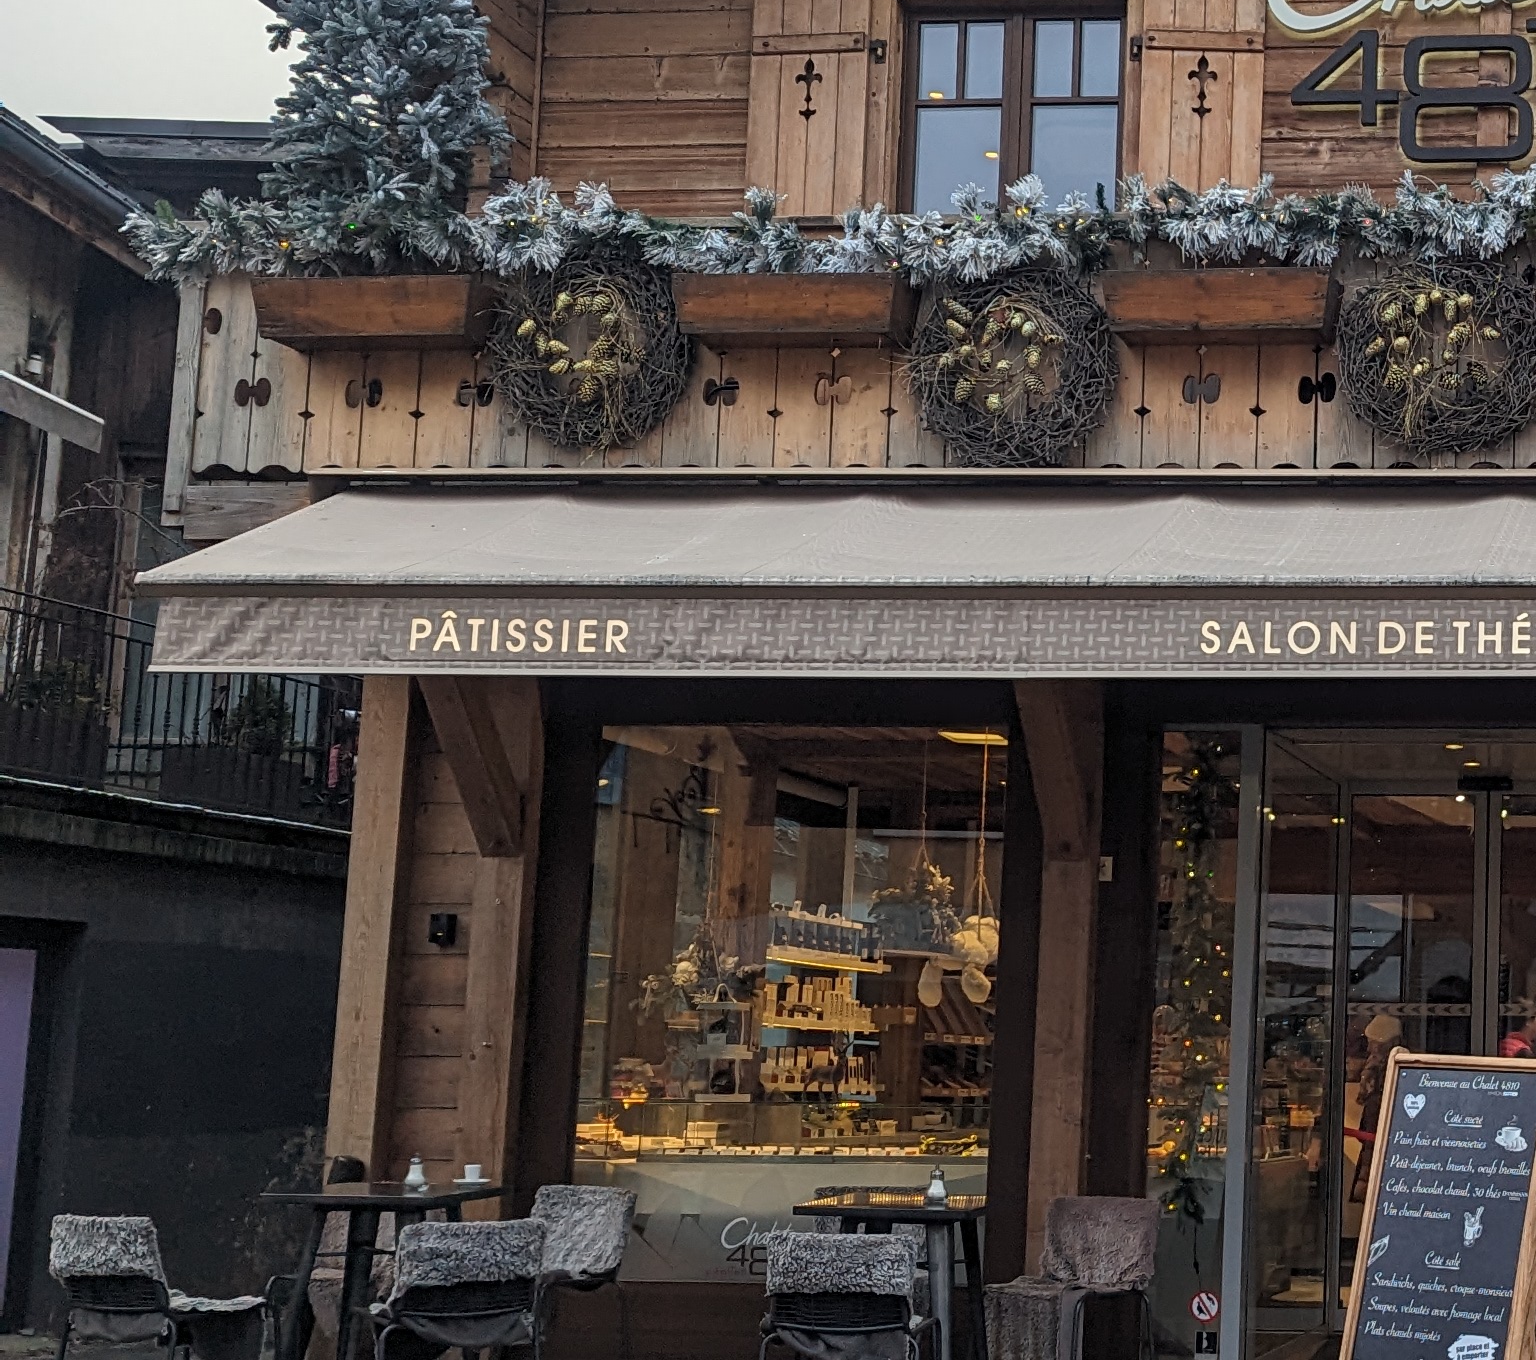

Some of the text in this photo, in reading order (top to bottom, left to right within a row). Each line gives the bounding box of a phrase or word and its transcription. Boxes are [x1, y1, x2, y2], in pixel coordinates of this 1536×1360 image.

[409, 610, 630, 654] PÂTISSIER
[1199, 612, 1531, 655] SALON DE THÉ
[1419, 1072, 1521, 1091] Bienvenue au Chalet 4810
[1444, 1109, 1463, 1124] Côté
[1393, 1130, 1487, 1149] Pain frais et viennoiseries
[1498, 1160, 1531, 1176] brouillés
[1411, 1179, 1444, 1195] chocolat
[1472, 1187, 1484, 1198] 30
[1485, 1183, 1502, 1199] thés
[1383, 1201, 1452, 1220] Vin chaud maison
[1400, 1298, 1430, 1316] veloutés
[1431, 1308, 1448, 1318] avec
[1447, 1302, 1482, 1323] fromage
[1484, 1305, 1505, 1322] local
[1364, 1320, 1441, 1343] Plats chauds mijotés
[1466, 1343, 1483, 1353] place
